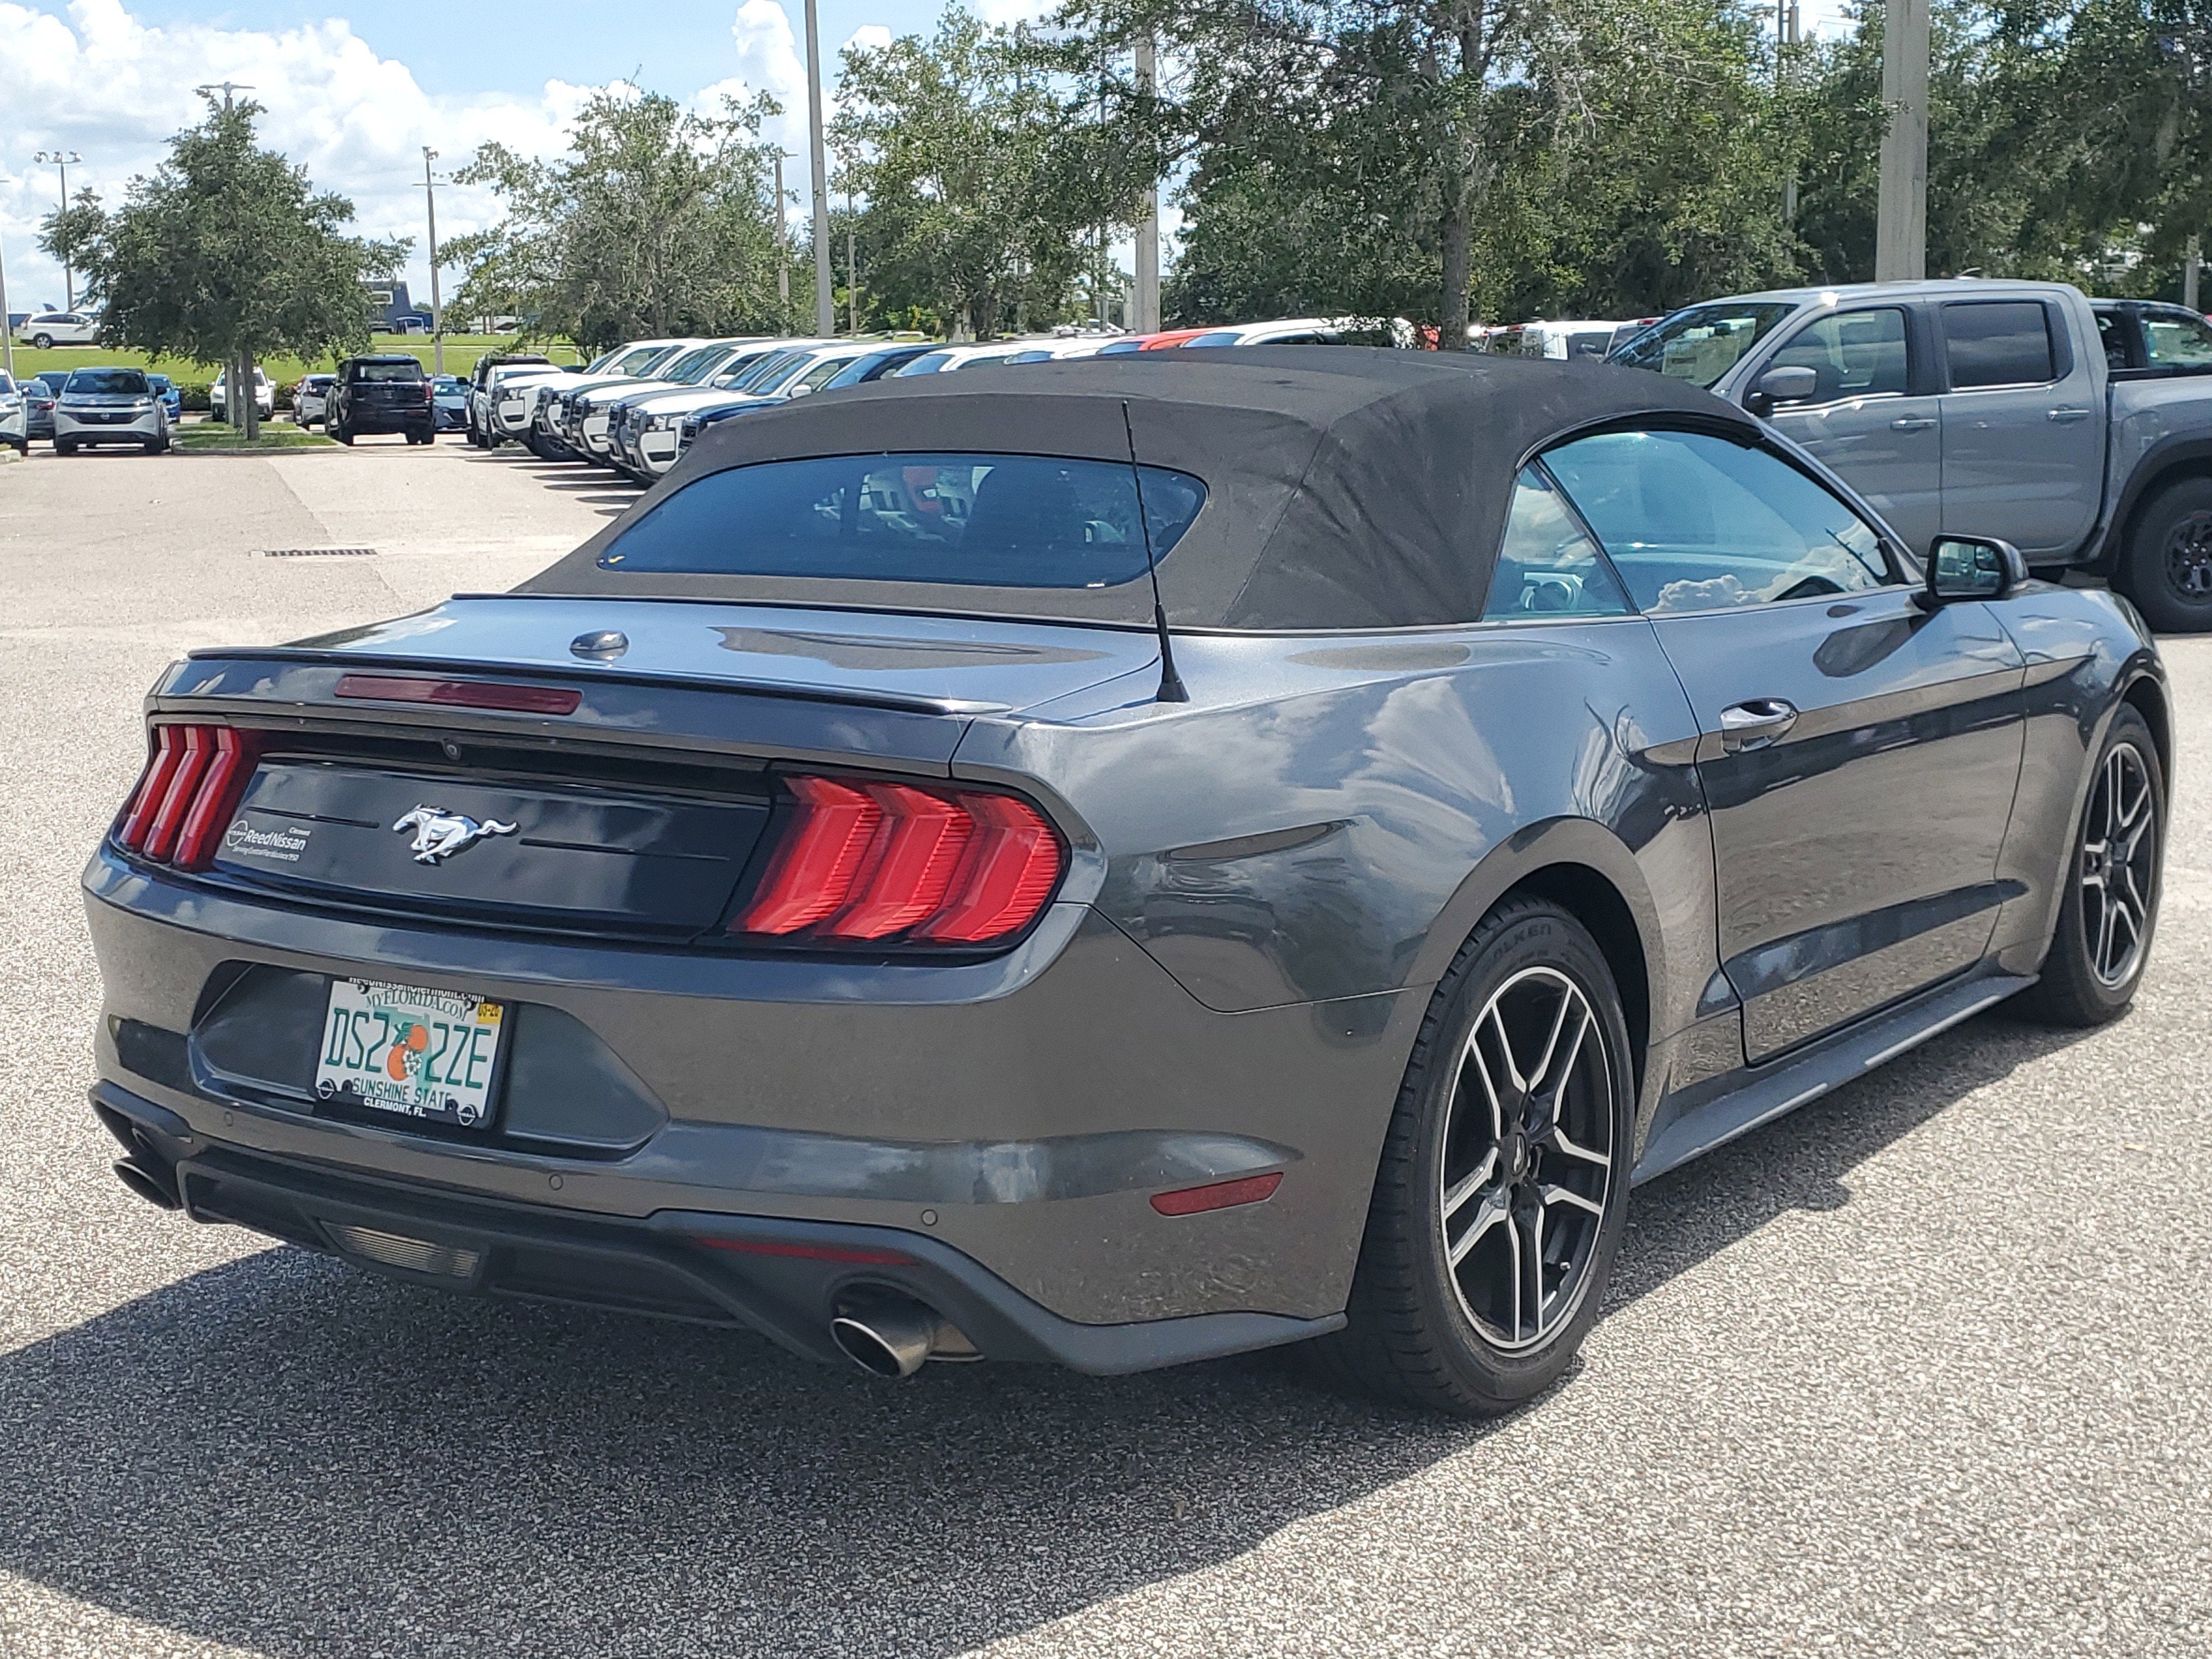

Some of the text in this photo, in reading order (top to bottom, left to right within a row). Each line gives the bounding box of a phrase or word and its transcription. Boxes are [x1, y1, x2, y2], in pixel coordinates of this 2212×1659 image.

[352, 1077, 410, 1103] SUNSHINE
[363, 1097, 427, 1118] CLERMONT, FL.
